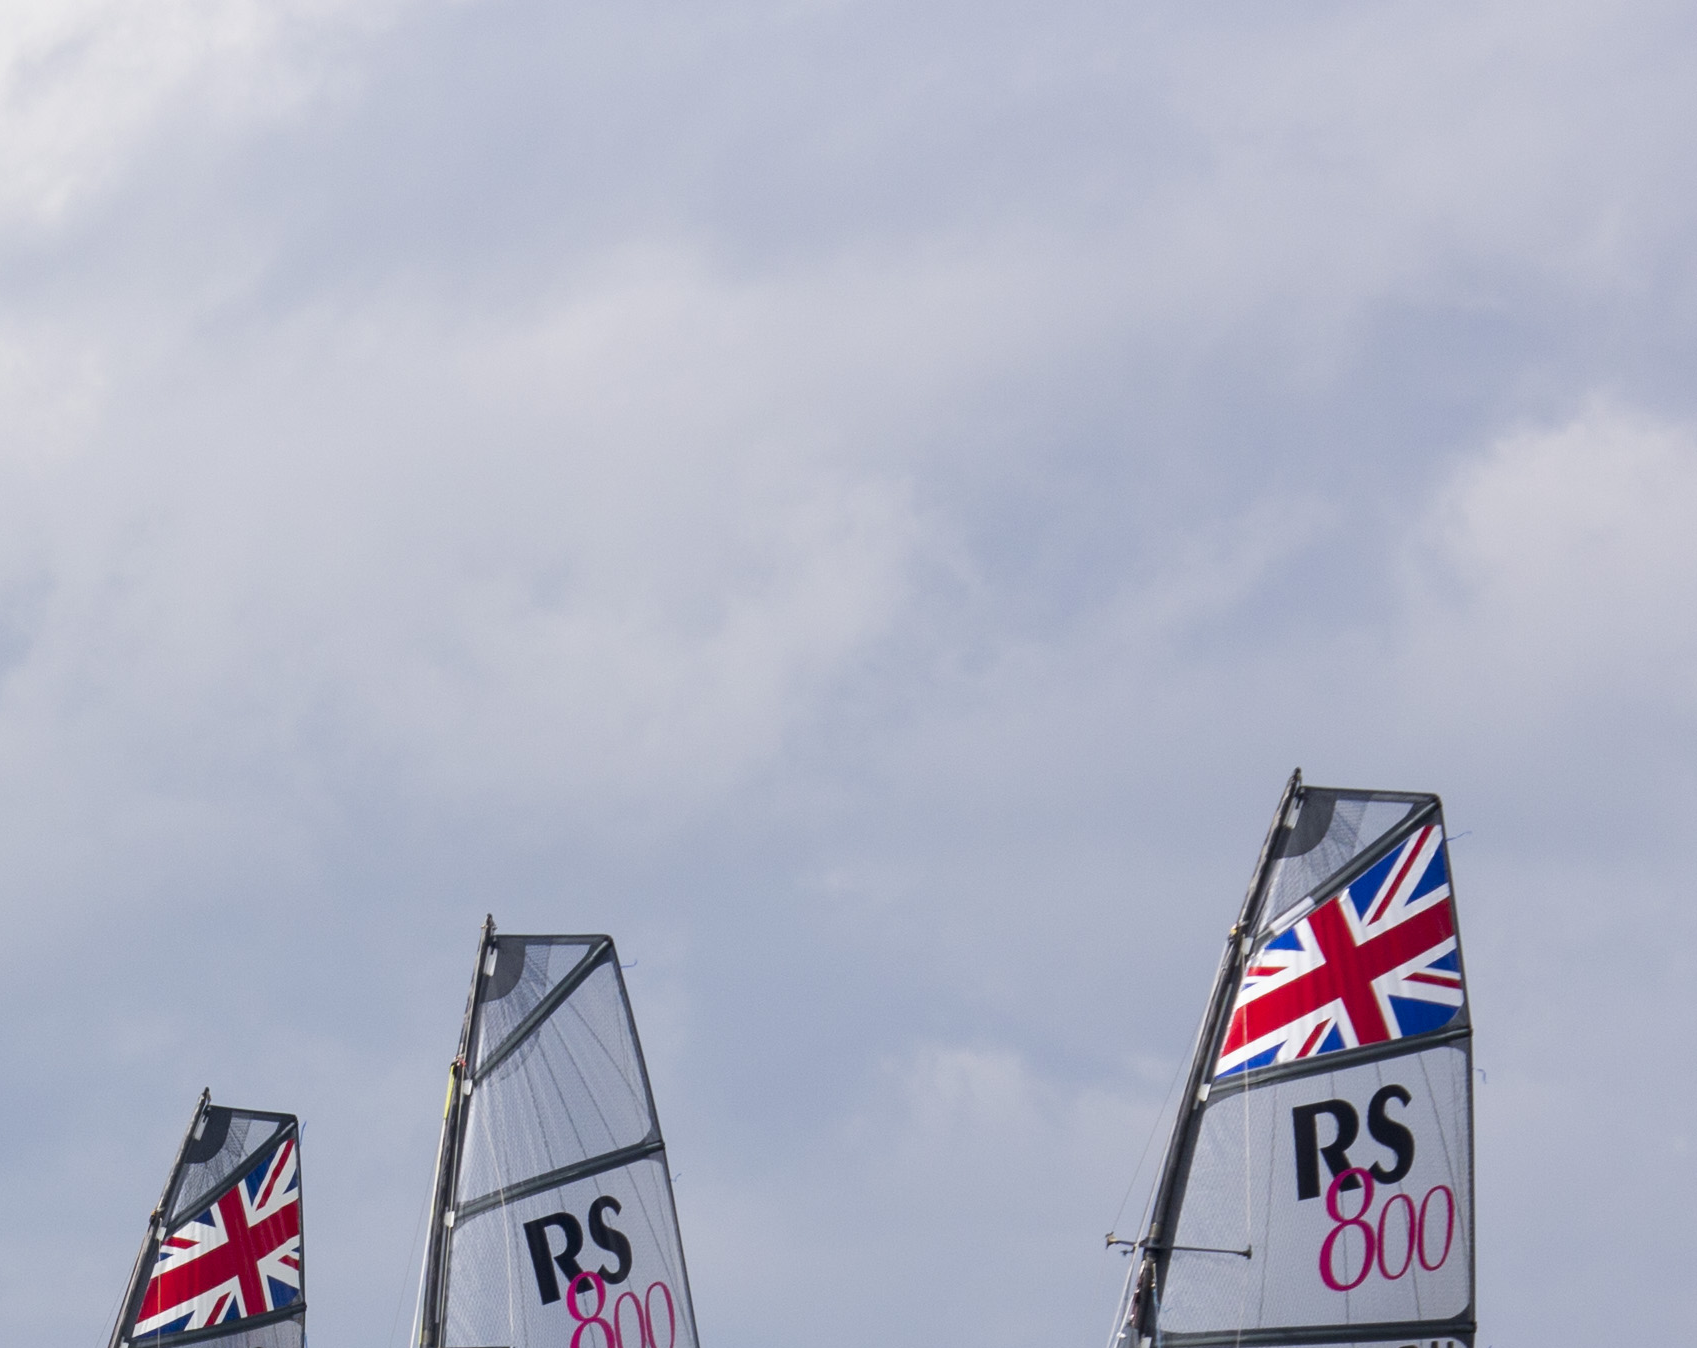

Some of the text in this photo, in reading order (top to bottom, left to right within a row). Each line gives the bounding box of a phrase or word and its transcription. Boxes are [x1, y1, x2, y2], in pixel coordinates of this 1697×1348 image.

[1292, 1084, 1415, 1201] RS
[523, 1195, 633, 1306] RS
[1319, 1167, 1454, 1292] 800
